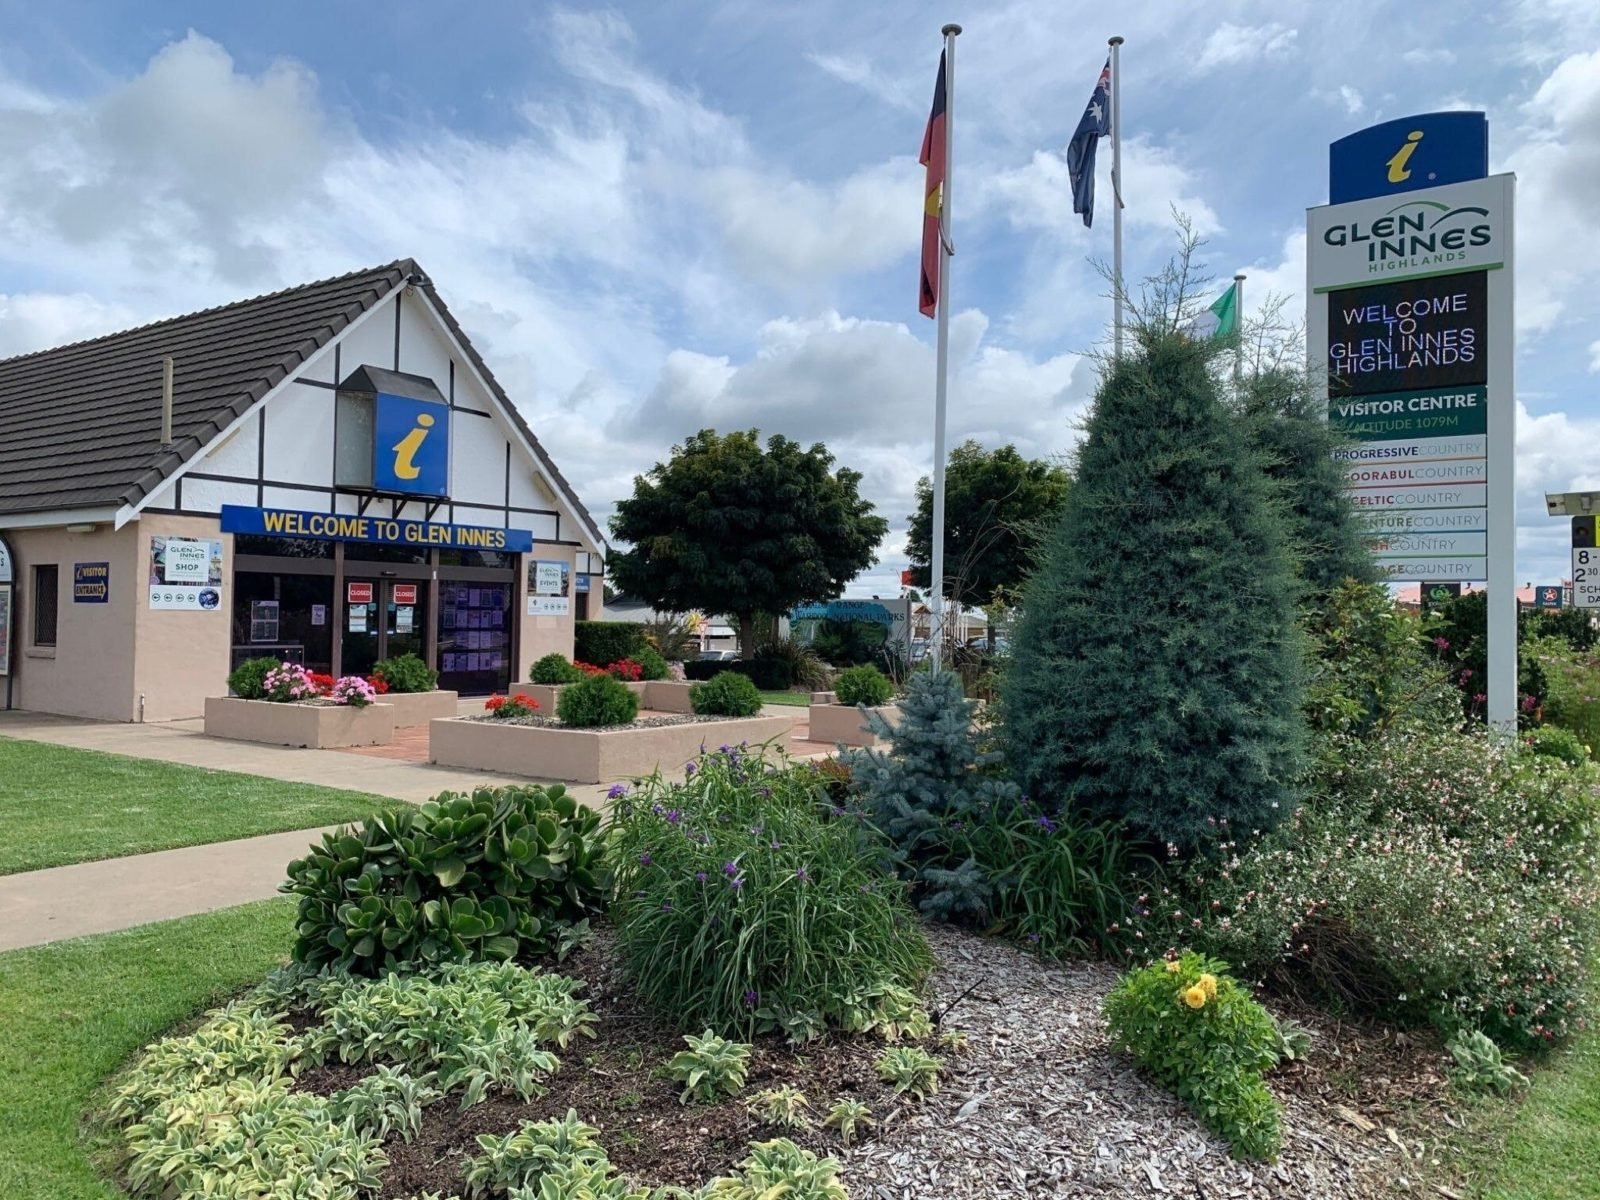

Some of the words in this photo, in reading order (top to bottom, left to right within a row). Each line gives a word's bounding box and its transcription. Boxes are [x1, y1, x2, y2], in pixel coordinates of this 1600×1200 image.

[1324, 212, 1424, 246] GLEN
[1369, 225, 1491, 261] INNES
[1369, 251, 1466, 272] HIGHLANDS
[1343, 293, 1467, 325] WELCOME
[1384, 318, 1417, 336] TO
[1330, 338, 1392, 359] GLEN
[1402, 328, 1475, 352] INNES
[1336, 346, 1475, 375] HIGHLANDS
[1338, 400, 1404, 417] VISITOR
[1408, 393, 1478, 411] CENTRE
[1354, 418, 1413, 433] ALTITUDE
[1417, 415, 1459, 429] 1079M
[263, 511, 369, 539] WELCOME
[374, 520, 399, 540] TO
[405, 523, 452, 544] GLEN
[457, 527, 506, 548] INNES
[175, 563, 199, 571] SHOP
[1578, 550, 1589, 564] 8
[82, 567, 107, 577] VISITOR
[76, 584, 104, 595] ENTRANCE
[876, 613, 905, 621] PARKS
